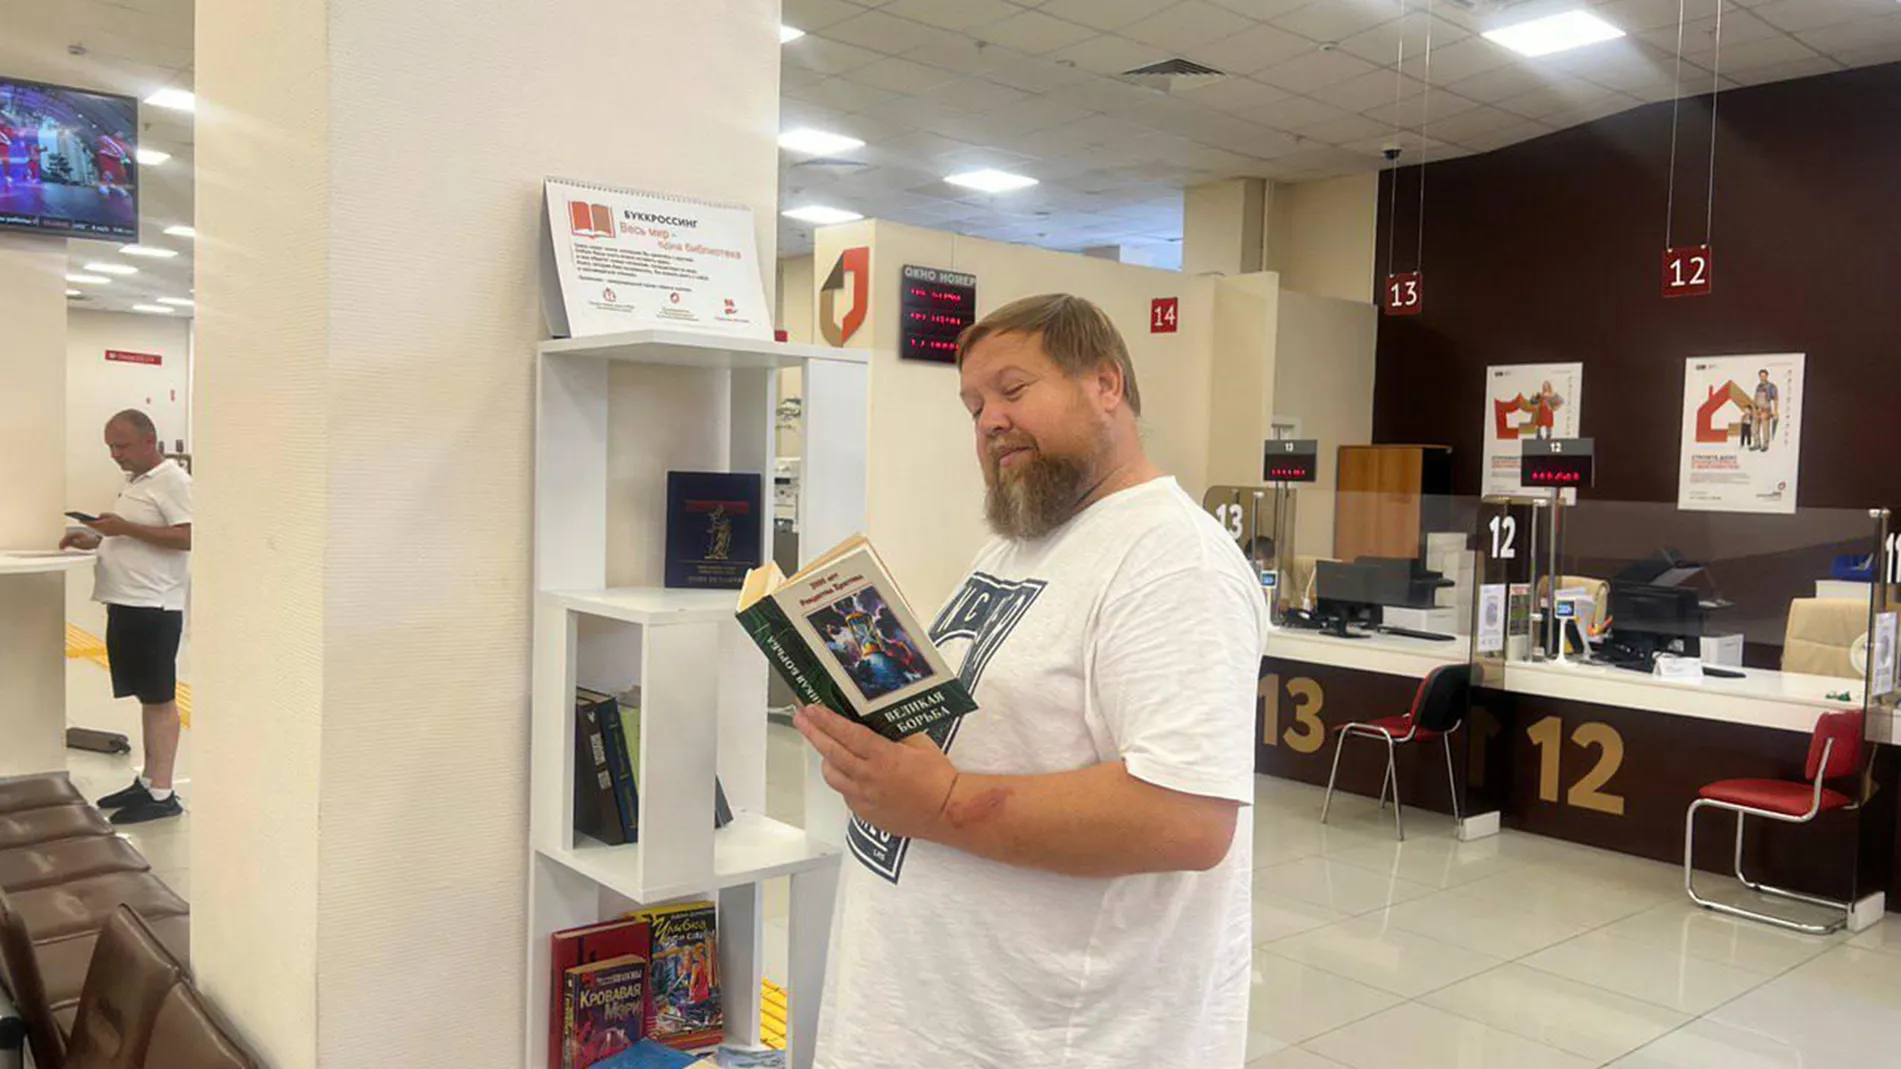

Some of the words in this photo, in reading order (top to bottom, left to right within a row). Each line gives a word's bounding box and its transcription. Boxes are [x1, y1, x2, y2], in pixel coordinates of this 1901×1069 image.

[620, 221, 647, 238] Весь
[648, 227, 670, 240] мир
[624, 210, 698, 228] БУККРОССИНГ
[684, 242, 742, 260] библиотека
[904, 266, 936, 281] ОКНО
[939, 273, 977, 288] НОМЕР
[1669, 257, 1706, 286] 12
[1390, 281, 1417, 306] 13
[1153, 304, 1176, 327] 14
[1285, 442, 1293, 452] 13
[1550, 442, 1561, 453] 12
[1216, 503, 1244, 538] 13
[1489, 515, 1516, 559] 12
[766, 634, 799, 677] БОРЬБА
[884, 690, 946, 723] ВЕЛИКАЯ
[1257, 673, 1325, 754] 13
[896, 707, 951, 734] БОРЬБА
[1526, 715, 1625, 815] 12
